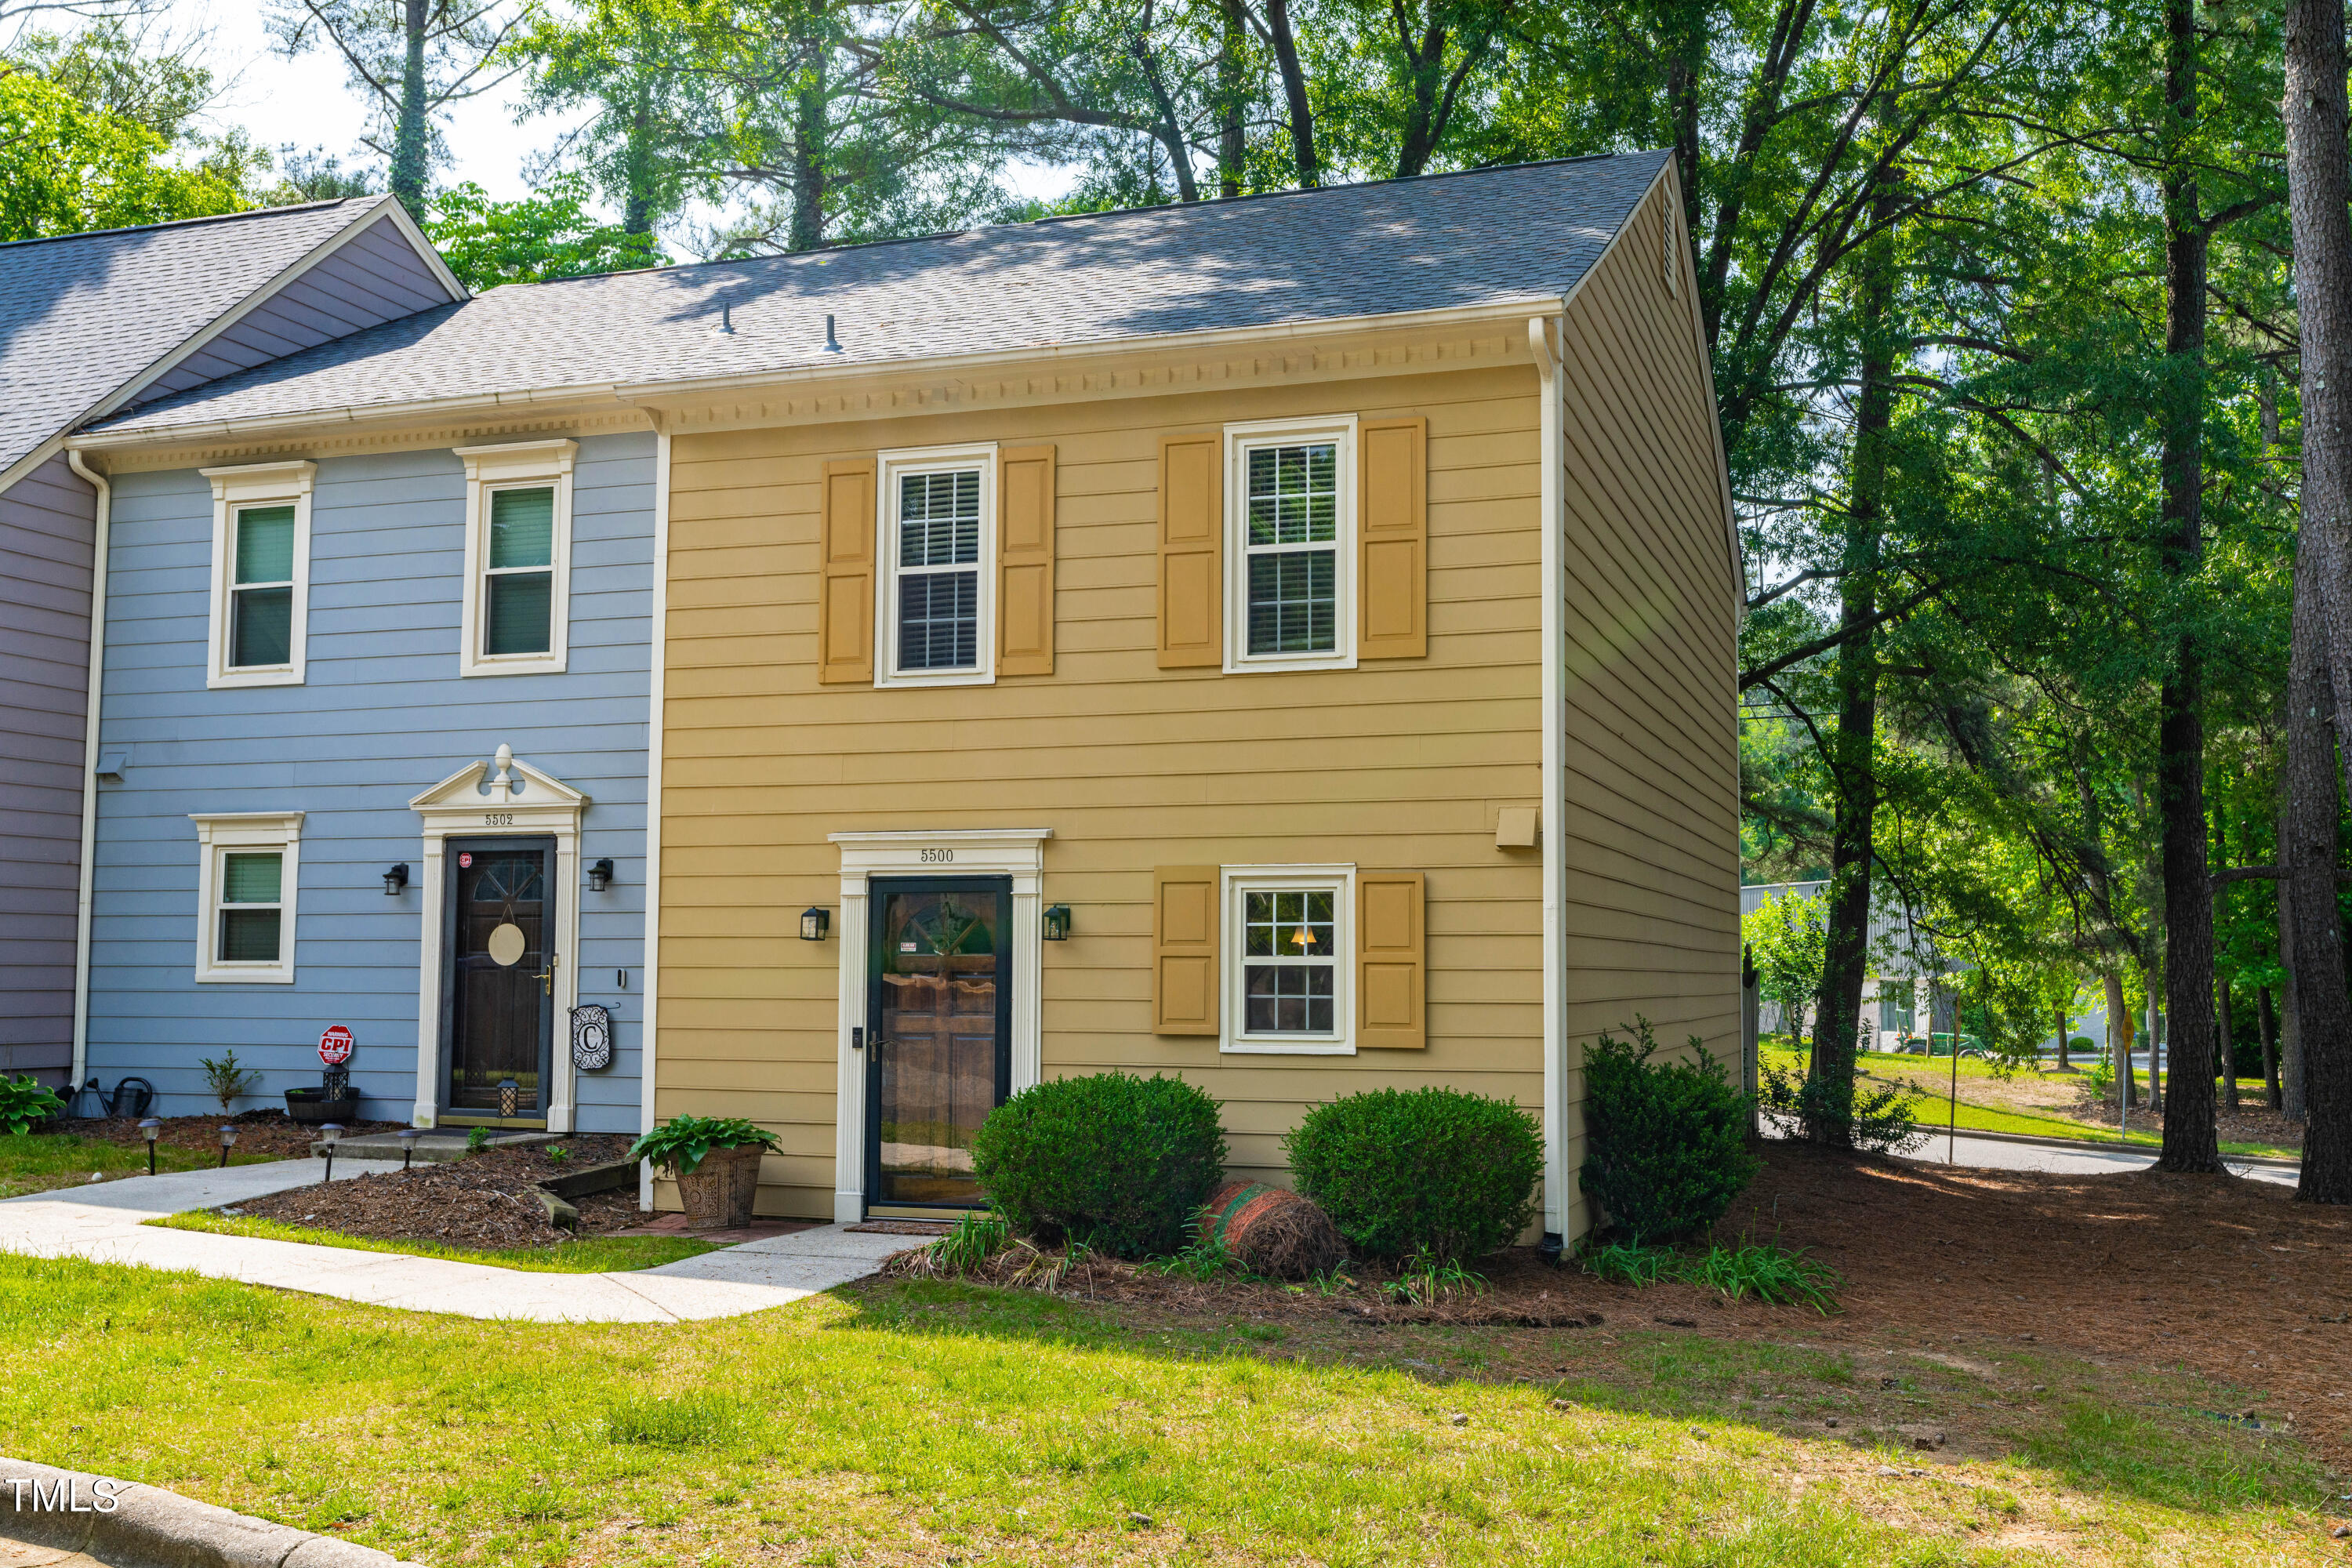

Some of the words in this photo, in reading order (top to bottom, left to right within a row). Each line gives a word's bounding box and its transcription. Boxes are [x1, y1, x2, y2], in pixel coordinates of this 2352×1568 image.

[485, 814, 513, 825] 5502
[921, 849, 953, 862] 5500
[583, 1025, 598, 1050] C
[321, 1038, 350, 1052] CPI
